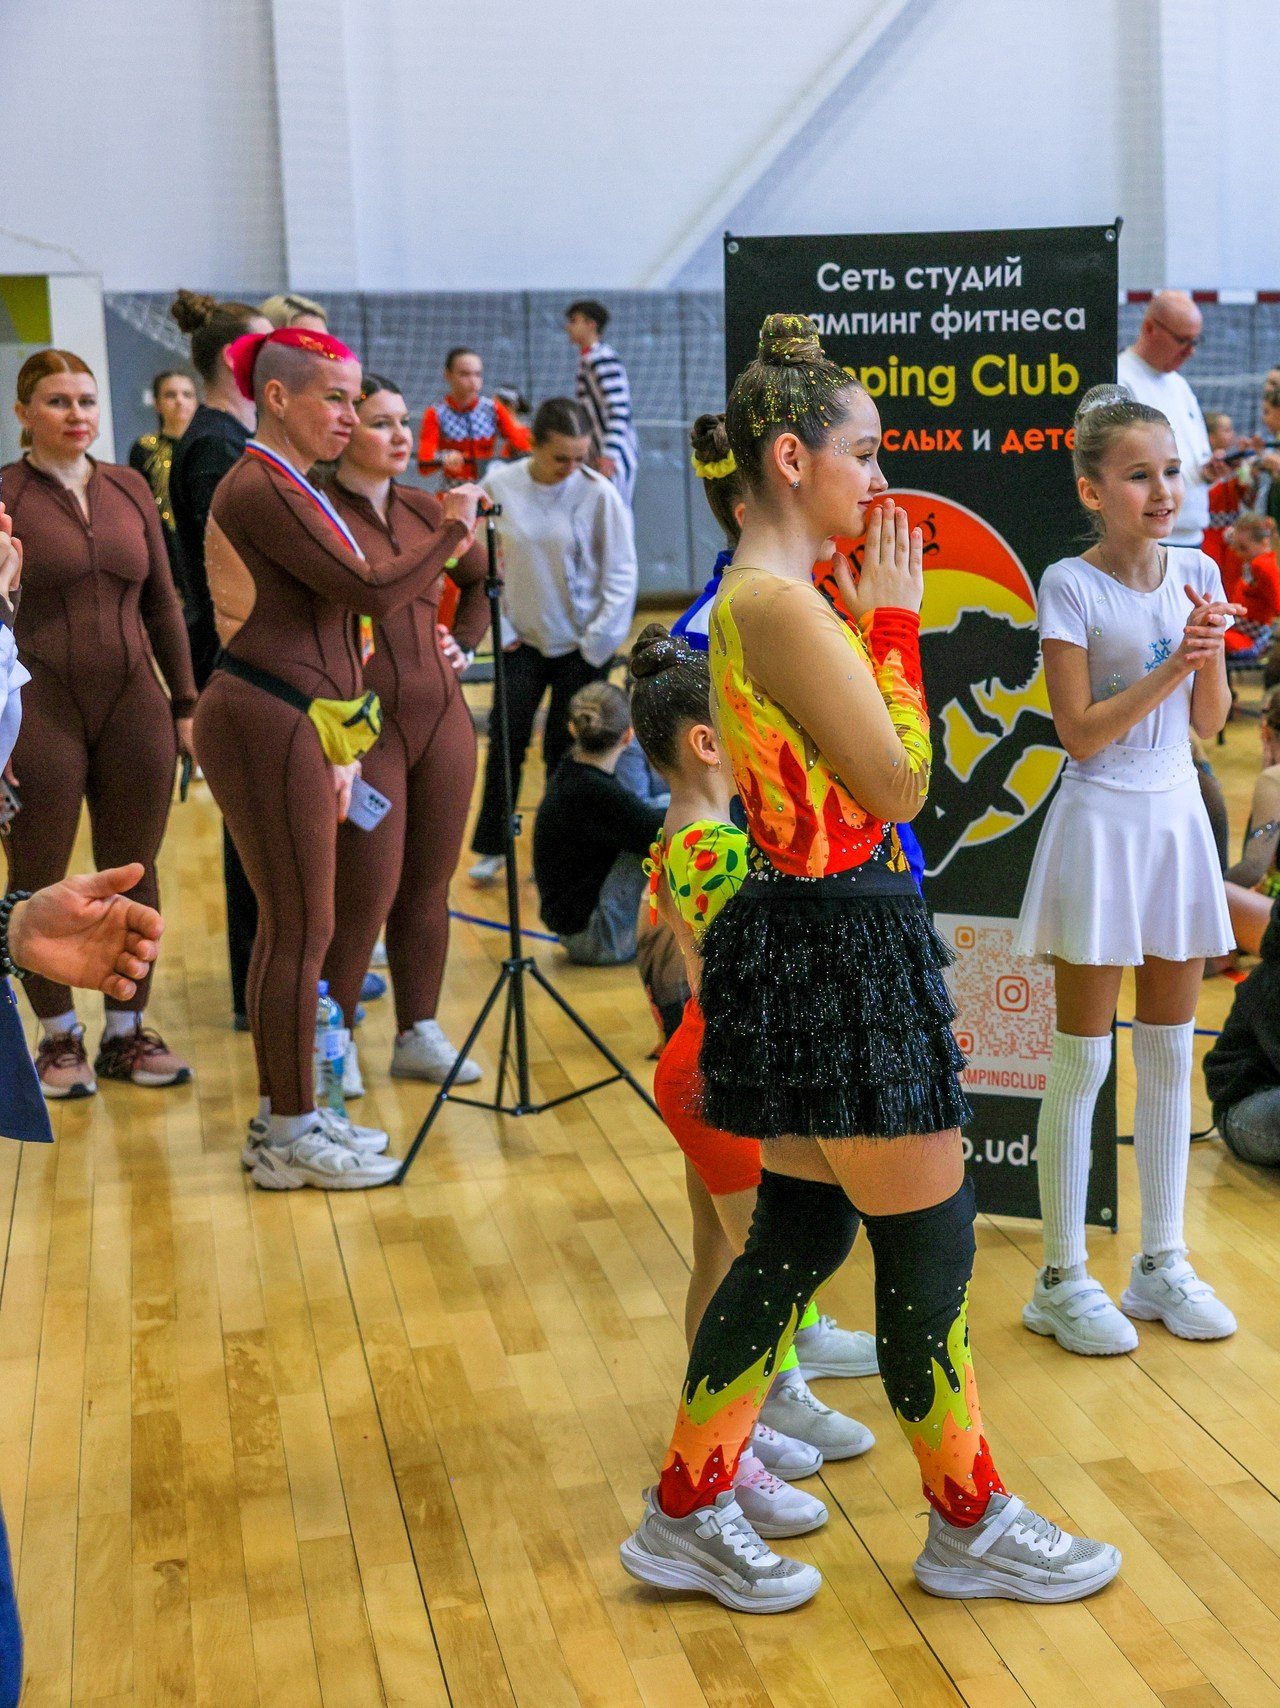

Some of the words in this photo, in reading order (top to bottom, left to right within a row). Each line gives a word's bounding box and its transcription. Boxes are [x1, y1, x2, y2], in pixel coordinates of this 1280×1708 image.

[816, 262, 896, 292] Сеть
[904, 256, 1023, 295] студий
[759, 311, 922, 337] ампинг
[930, 304, 1086, 340] фитнеса
[842, 355, 956, 407] ping
[971, 352, 1080, 396] Club
[882, 428, 963, 452] слых
[972, 428, 991, 451] и
[1001, 427, 1076, 454] дете
[961, 1068, 1047, 1091] MPINGCLUB
